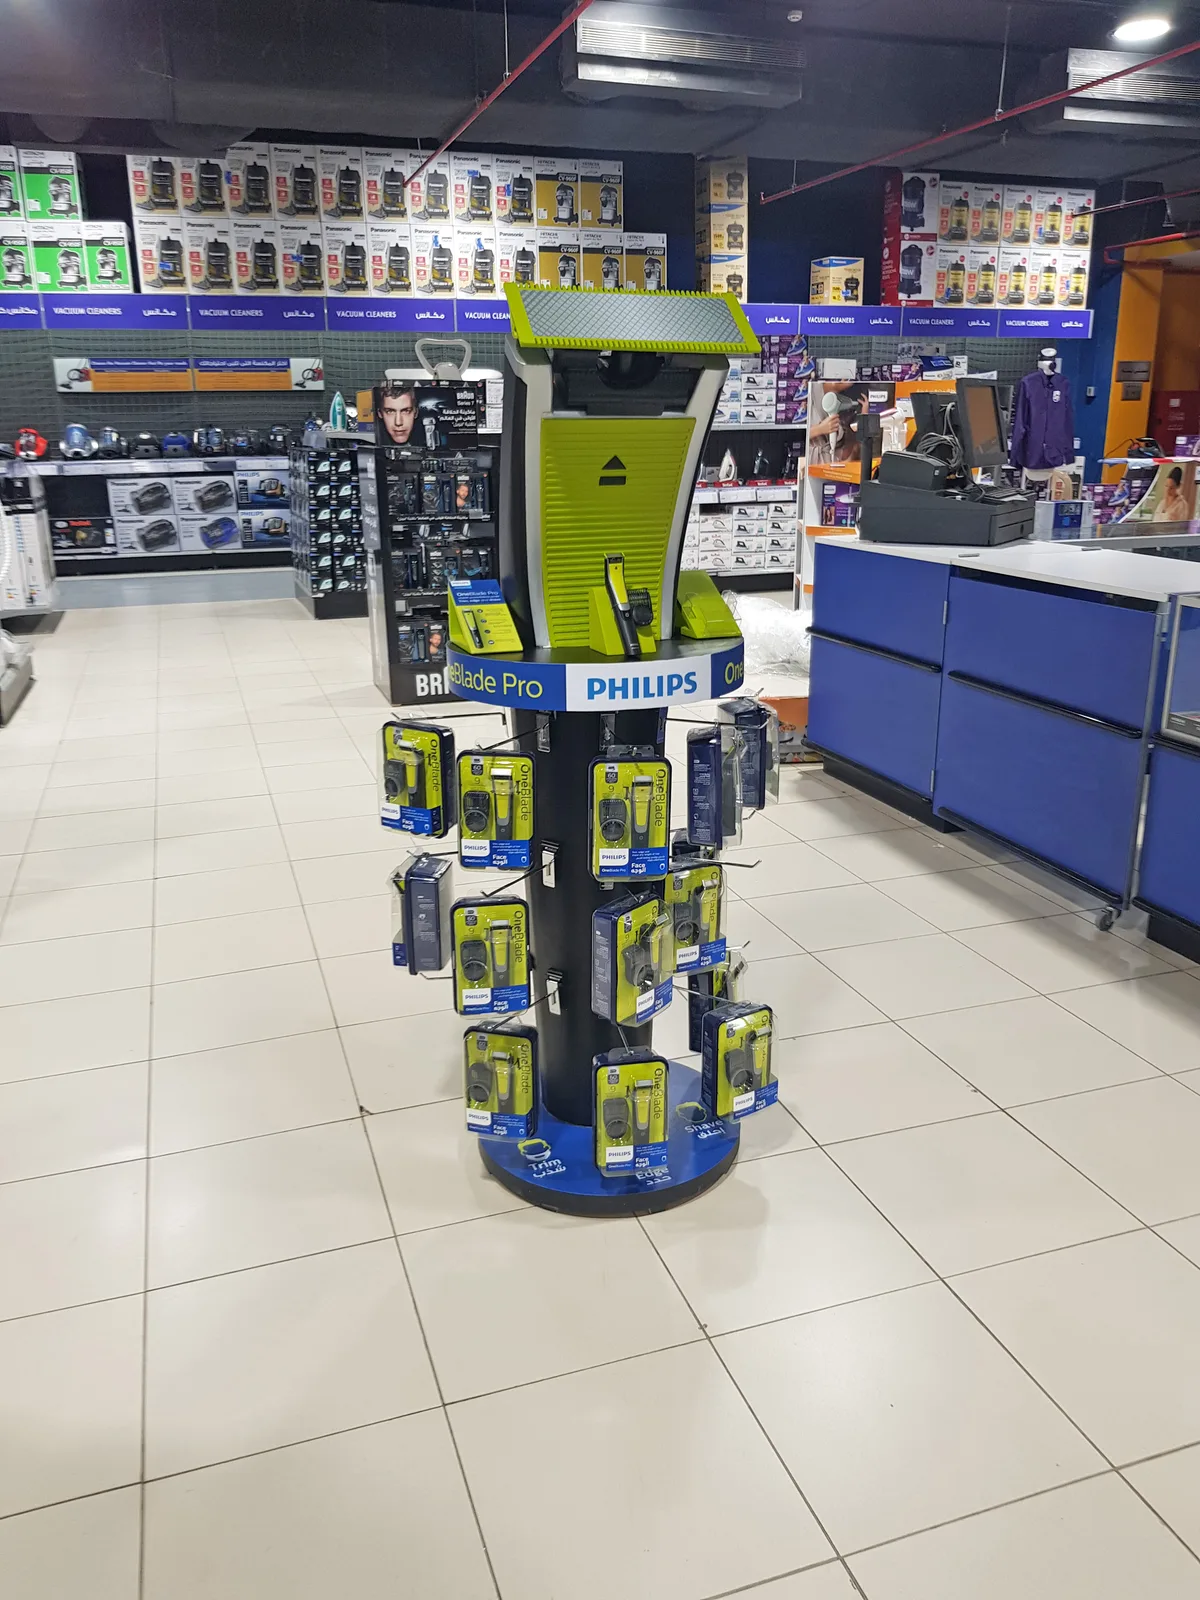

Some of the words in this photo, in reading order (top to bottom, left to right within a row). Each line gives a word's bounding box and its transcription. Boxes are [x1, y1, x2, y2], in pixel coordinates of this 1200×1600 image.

[53, 307, 85, 315] VACUUM
[142, 308, 177, 316] مكانس
[199, 309, 228, 317] VACUUM
[230, 309, 263, 317] CLEANERS
[283, 310, 315, 318] مكانس
[366, 310, 397, 318] CLEANERS
[415, 312, 445, 320] مكانس
[765, 315, 790, 323] مكانس
[830, 316, 855, 324] CLEANERS
[931, 318, 954, 326] CLEANERS
[503, 673, 543, 698] Pro
[587, 671, 697, 700] PHILIPS
[430, 738, 441, 792] OneBlade
[520, 764, 531, 822] OneBlade
[654, 769, 666, 826] OneBlade
[514, 910, 523, 963] OneBlade
[654, 1068, 663, 1119] OneBlade
[684, 1120, 723, 1133] Shave
[528, 1158, 562, 1171] Trim
[636, 1167, 669, 1180] Edge
[646, 1176, 672, 1185] حدد
